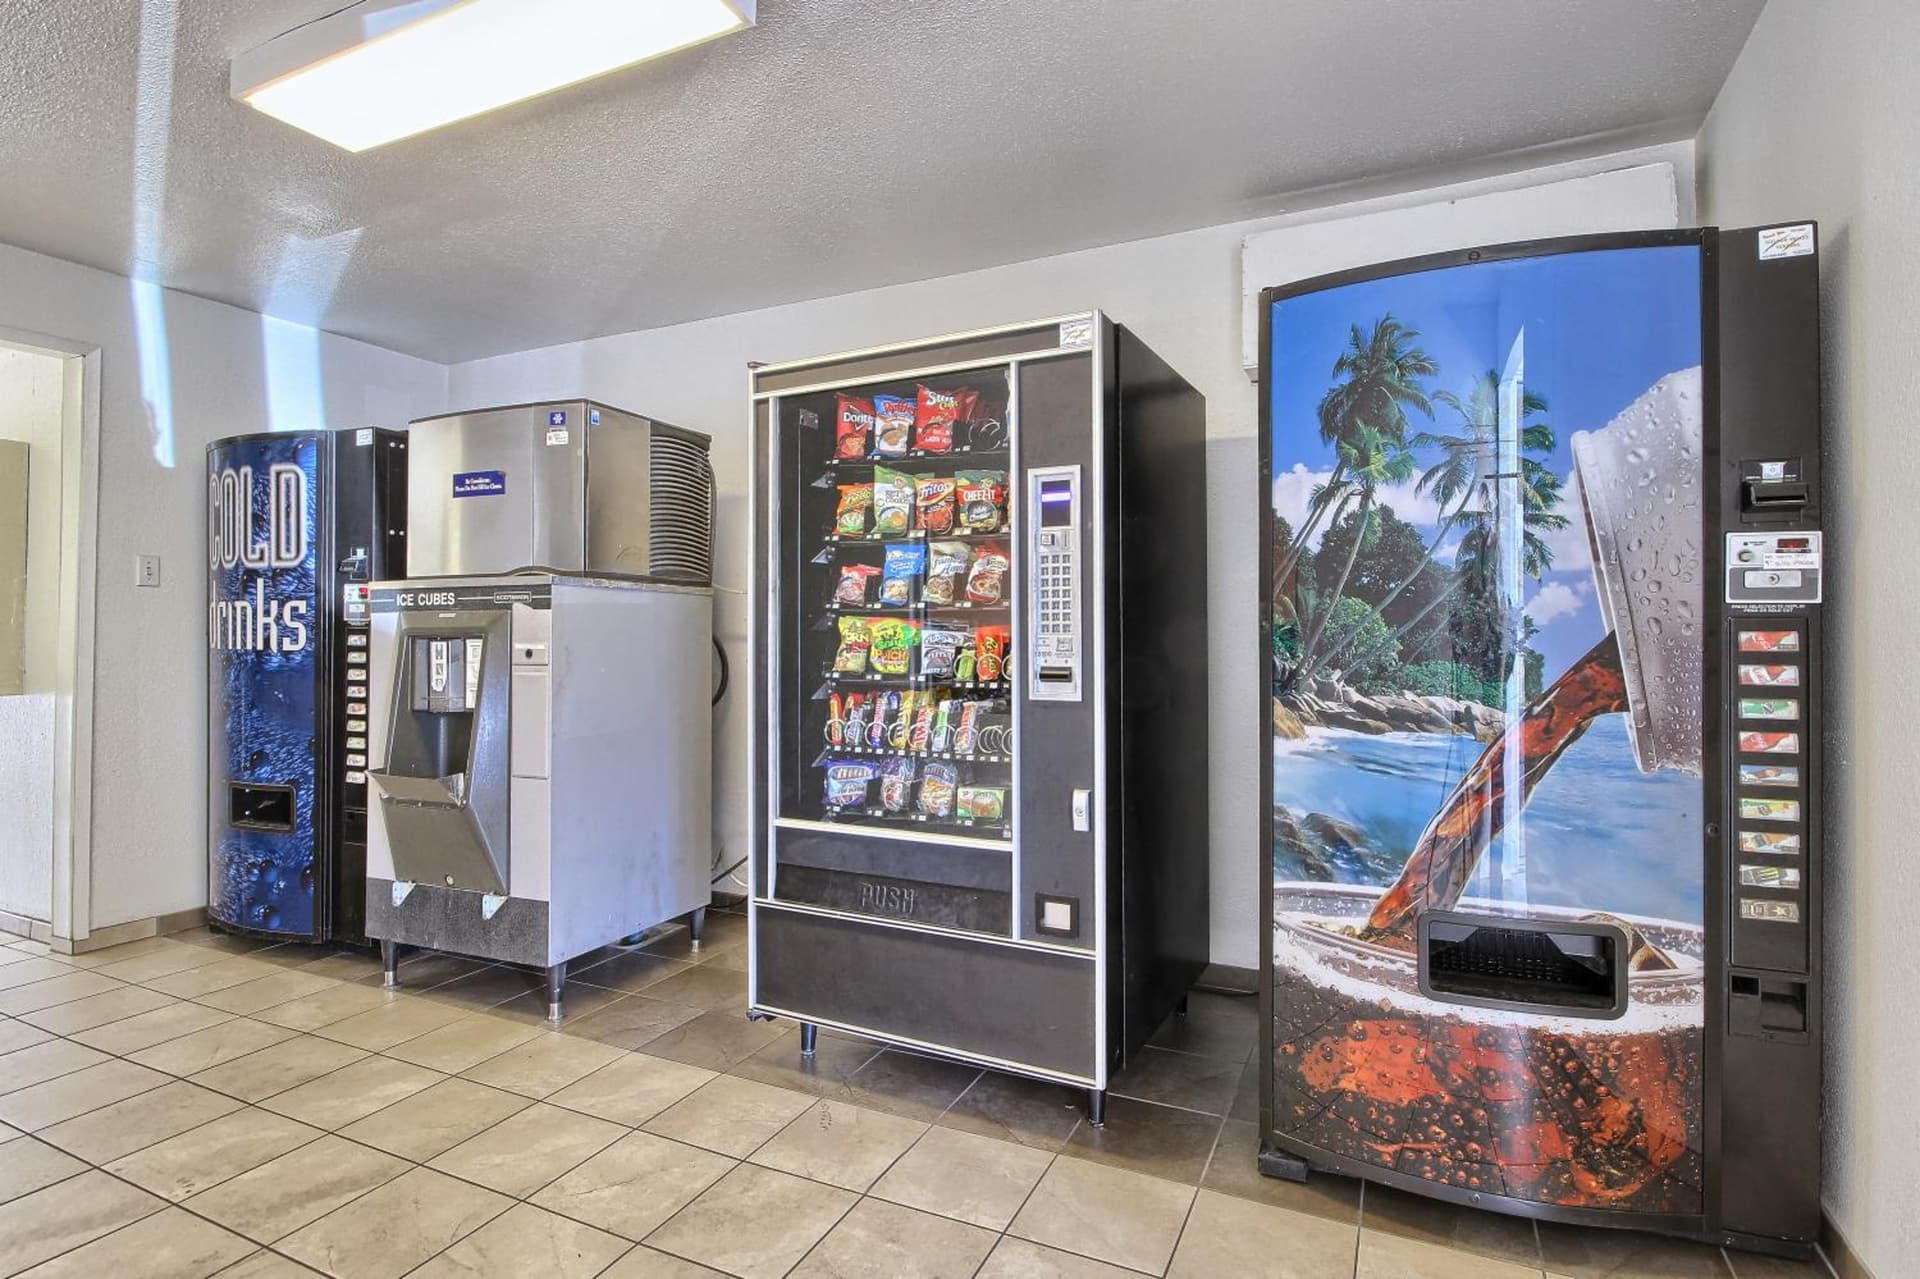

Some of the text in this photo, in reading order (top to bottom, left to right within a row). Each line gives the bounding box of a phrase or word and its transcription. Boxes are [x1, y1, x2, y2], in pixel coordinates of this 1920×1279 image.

[209, 463, 308, 570] COLD
[209, 578, 308, 654] drinks
[396, 592, 455, 607] ICE CUBES
[860, 882, 916, 913] PUSH
